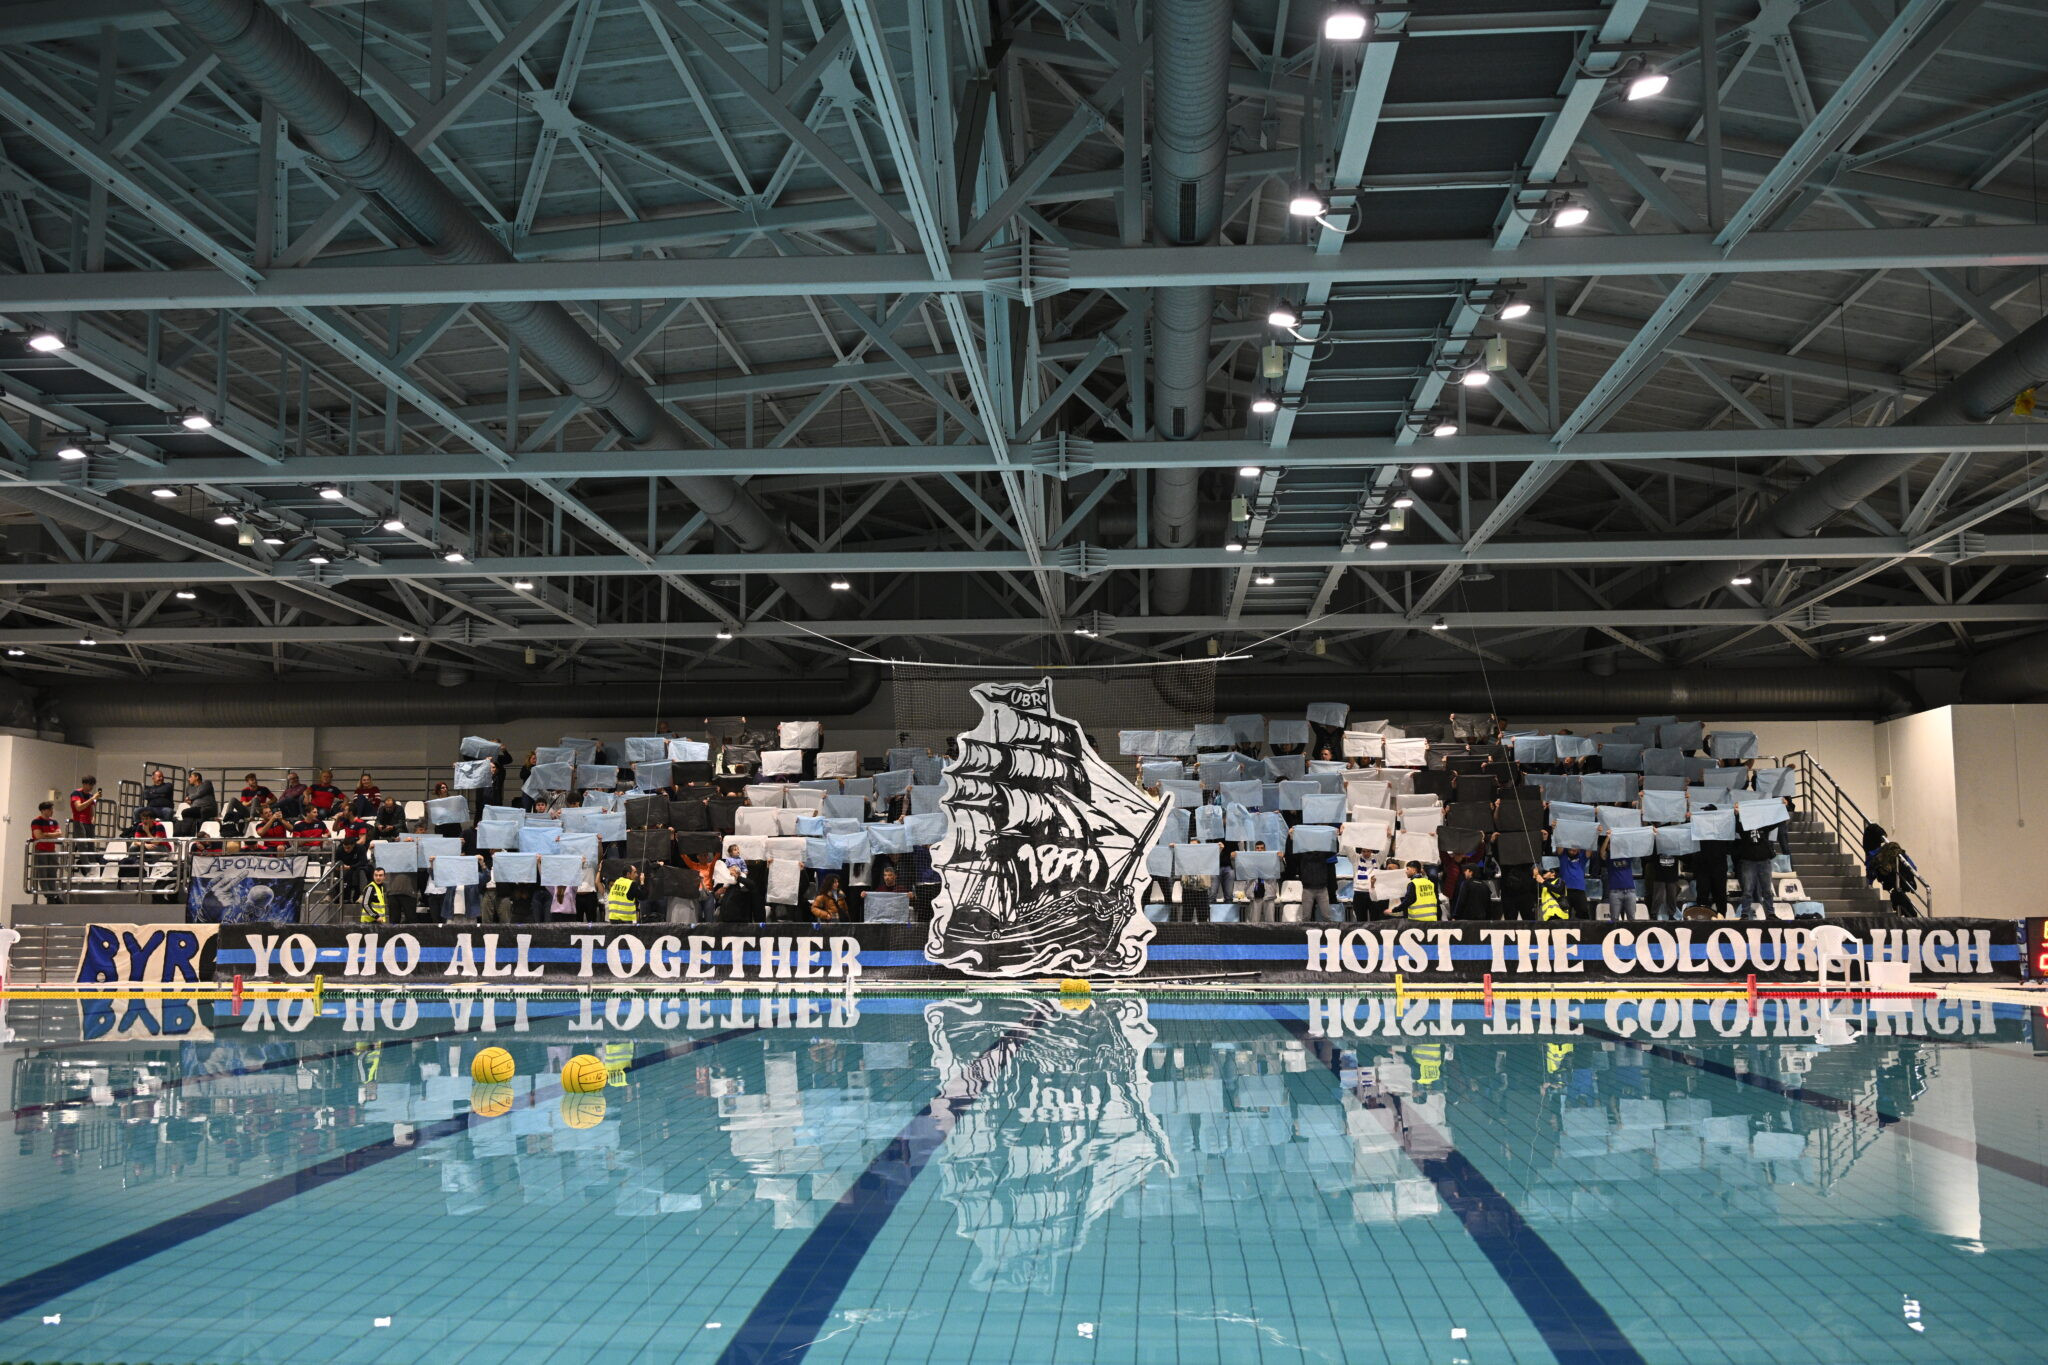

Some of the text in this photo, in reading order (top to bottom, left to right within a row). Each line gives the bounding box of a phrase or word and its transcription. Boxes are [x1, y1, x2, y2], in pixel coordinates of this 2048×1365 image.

[202, 856, 295, 876] APOLLON
[1017, 844, 1100, 889] 1891
[245, 933, 862, 978] YO-HO ALL TOGETHER
[1305, 928, 1462, 973] HOIST
[1480, 928, 1584, 973] THE
[1870, 928, 1994, 973] HIGH
